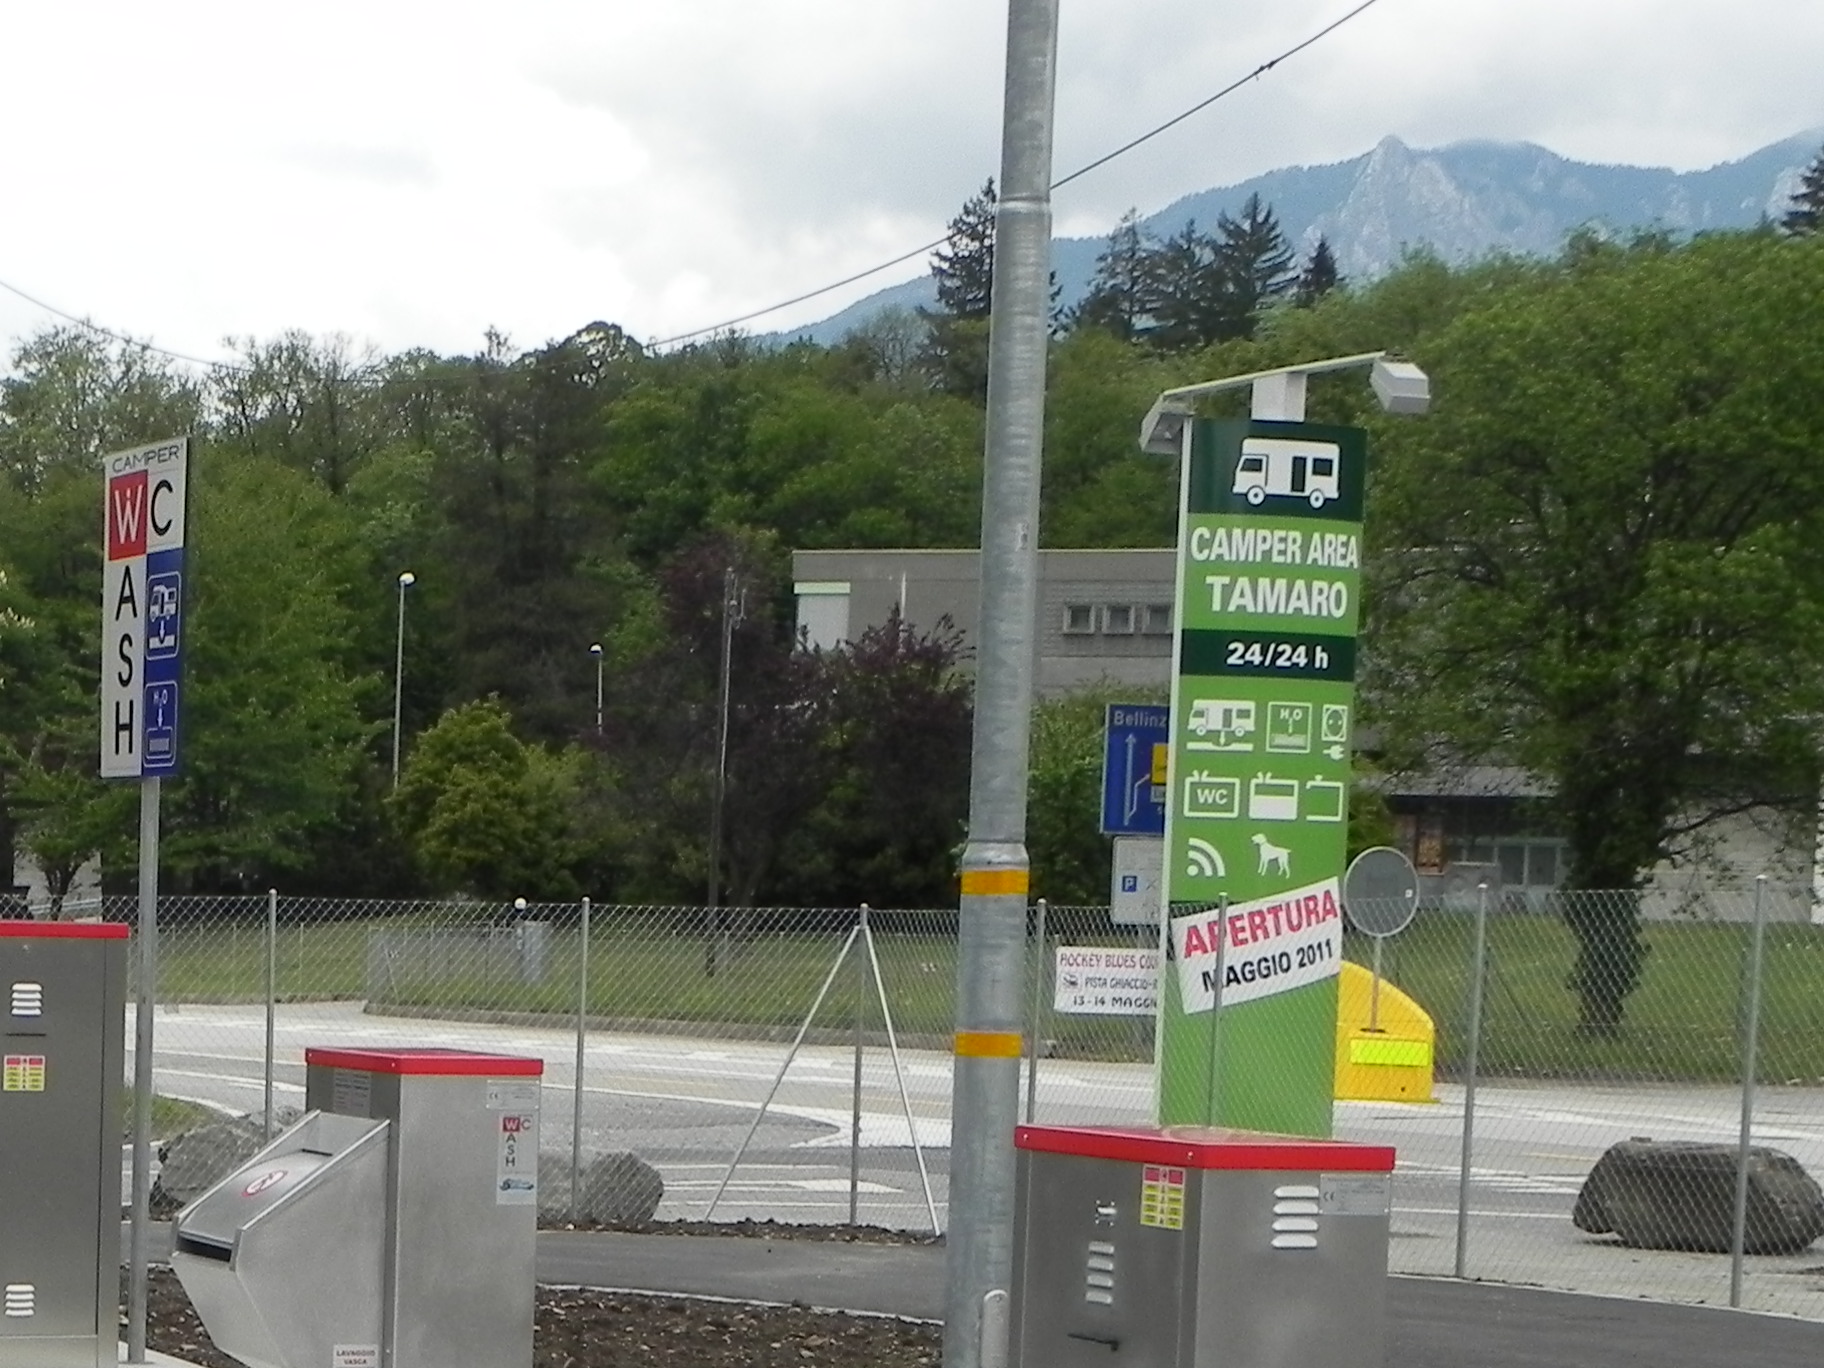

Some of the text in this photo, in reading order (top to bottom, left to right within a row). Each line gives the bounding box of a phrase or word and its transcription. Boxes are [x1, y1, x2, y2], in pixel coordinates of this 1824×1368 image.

[1190, 526, 1359, 569] CAMPER AREA
[1205, 575, 1348, 618] TAMARO
[1226, 641, 1329, 669] 24/24 h
[1197, 788, 1228, 805] WC
[1297, 938, 1334, 968] 2011
